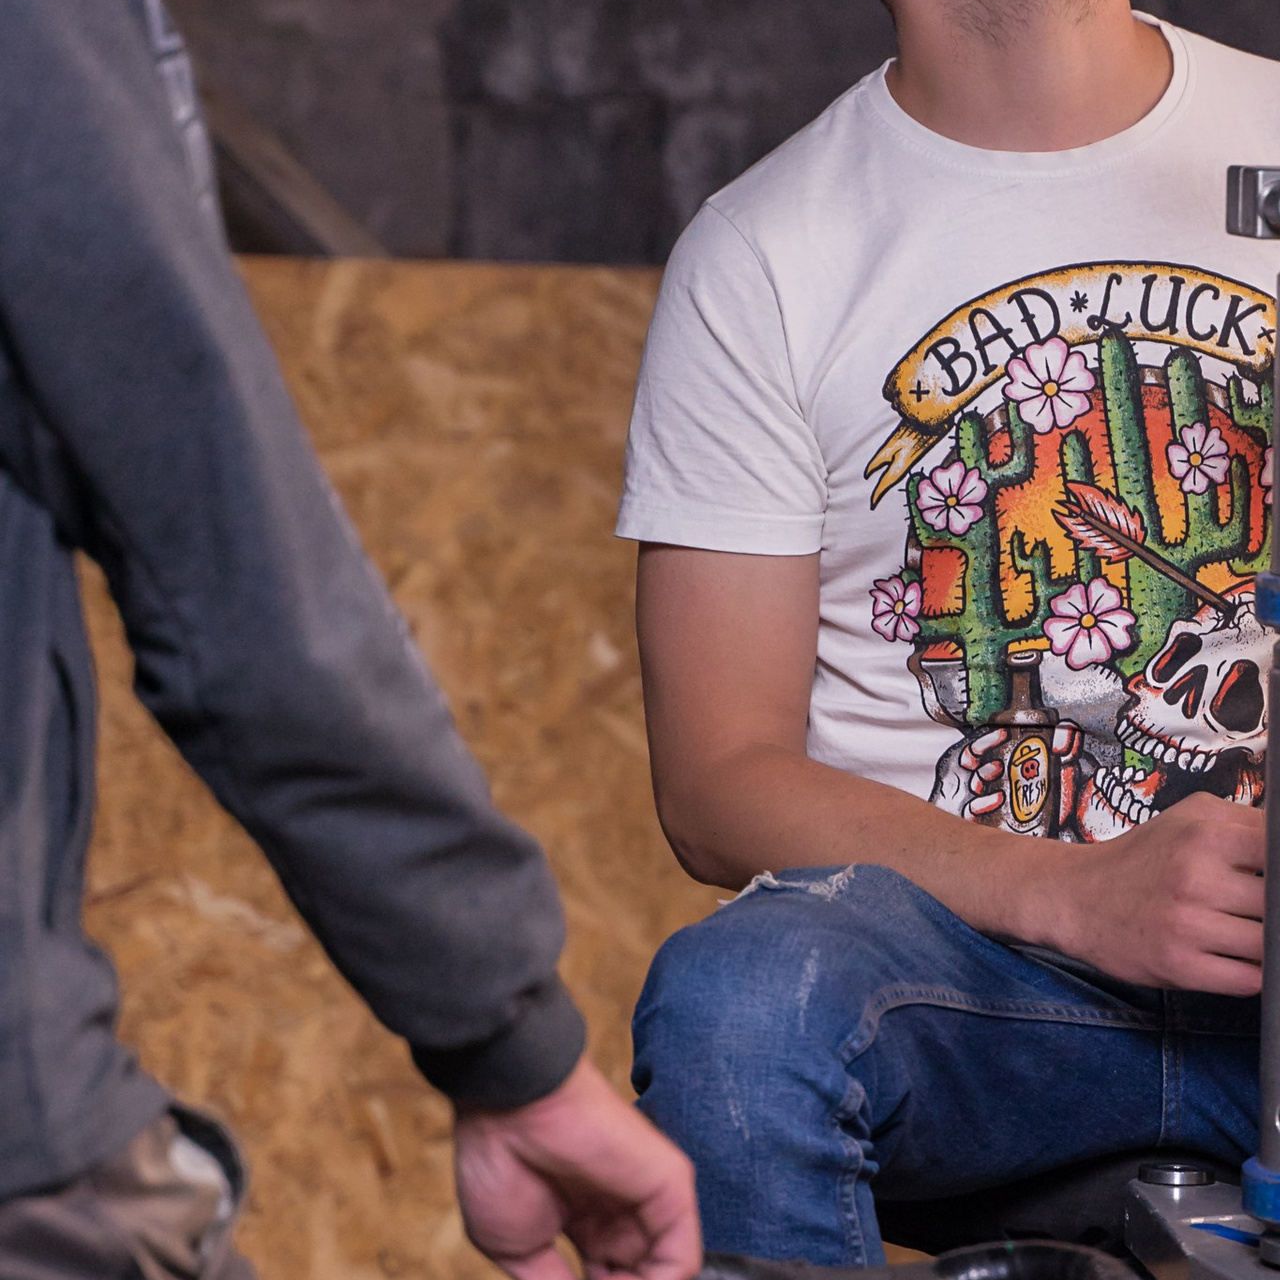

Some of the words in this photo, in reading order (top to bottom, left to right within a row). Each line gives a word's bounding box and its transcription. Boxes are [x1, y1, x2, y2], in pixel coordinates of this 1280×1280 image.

[924, 287, 1060, 397] BAD
[1087, 273, 1268, 357] LUCK
[1014, 778, 1046, 812] FRESH
